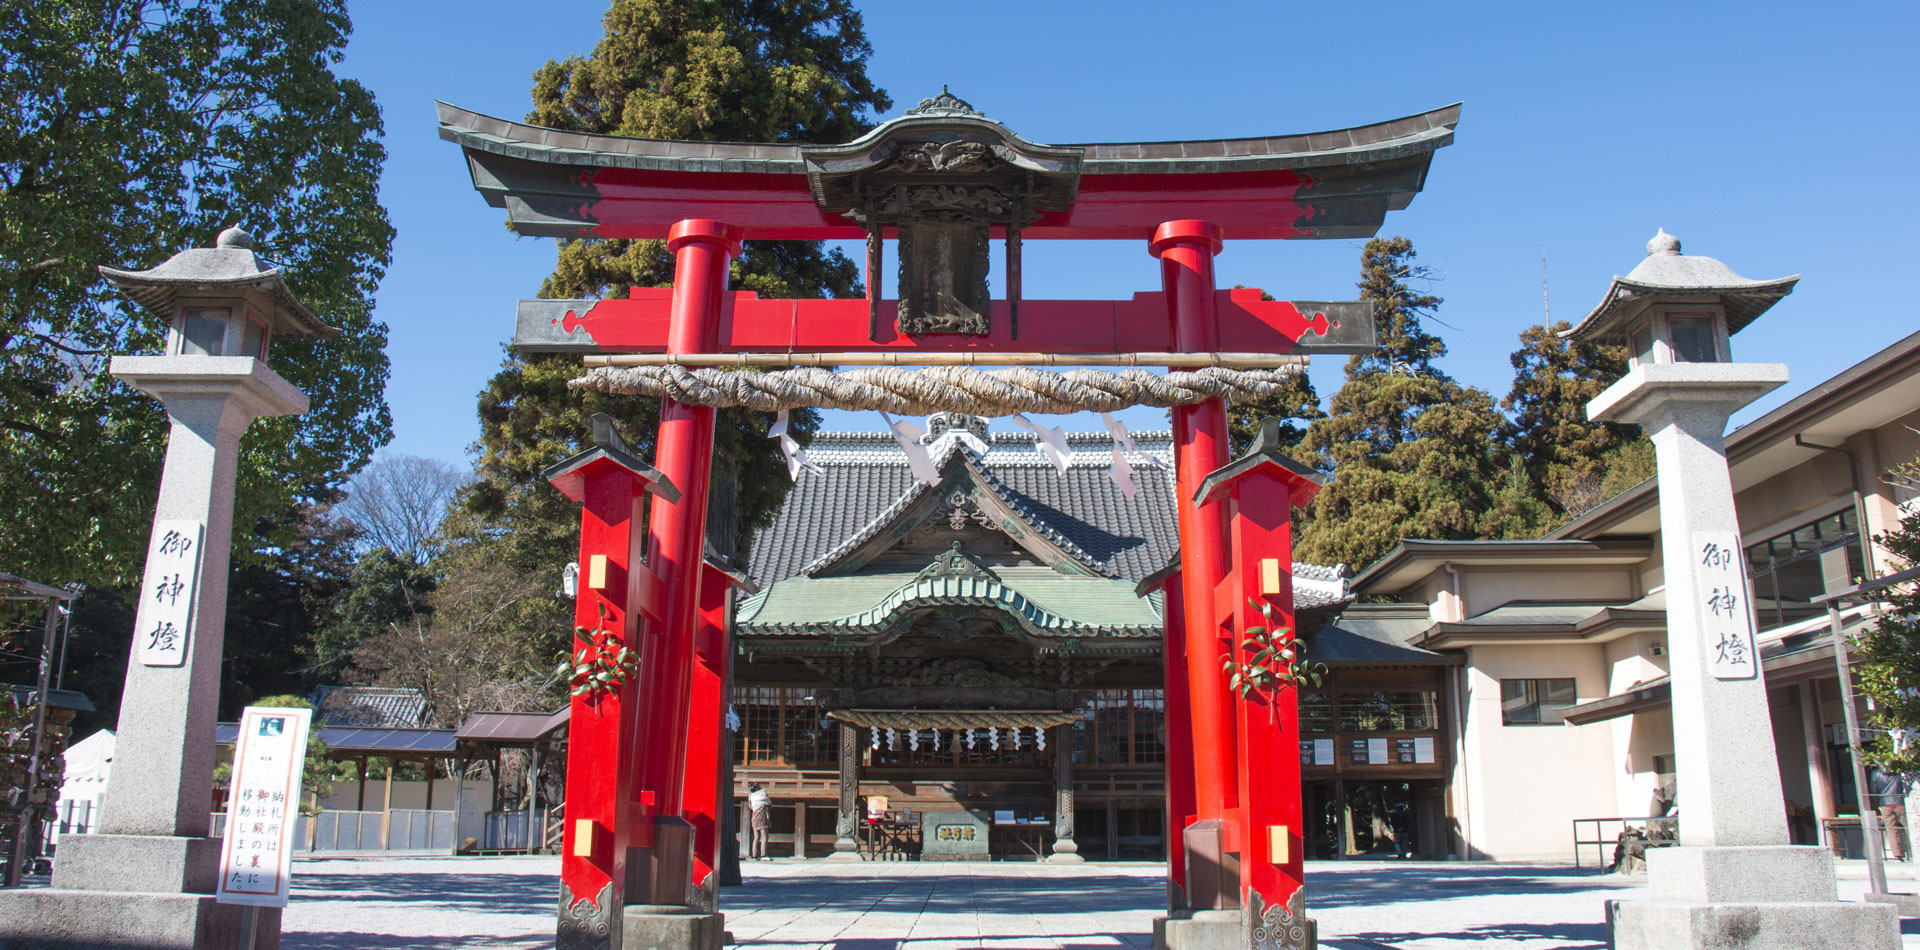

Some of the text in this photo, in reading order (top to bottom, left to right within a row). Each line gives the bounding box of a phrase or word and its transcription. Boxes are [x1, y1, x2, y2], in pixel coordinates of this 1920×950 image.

[147, 529, 193, 652] 御神燈
[1702, 542, 1750, 665] 御神燈
[231, 788, 253, 890] 移動しました。
[247, 789, 270, 884] 御社殿の裏に
[266, 790, 284, 851] 納札所は
